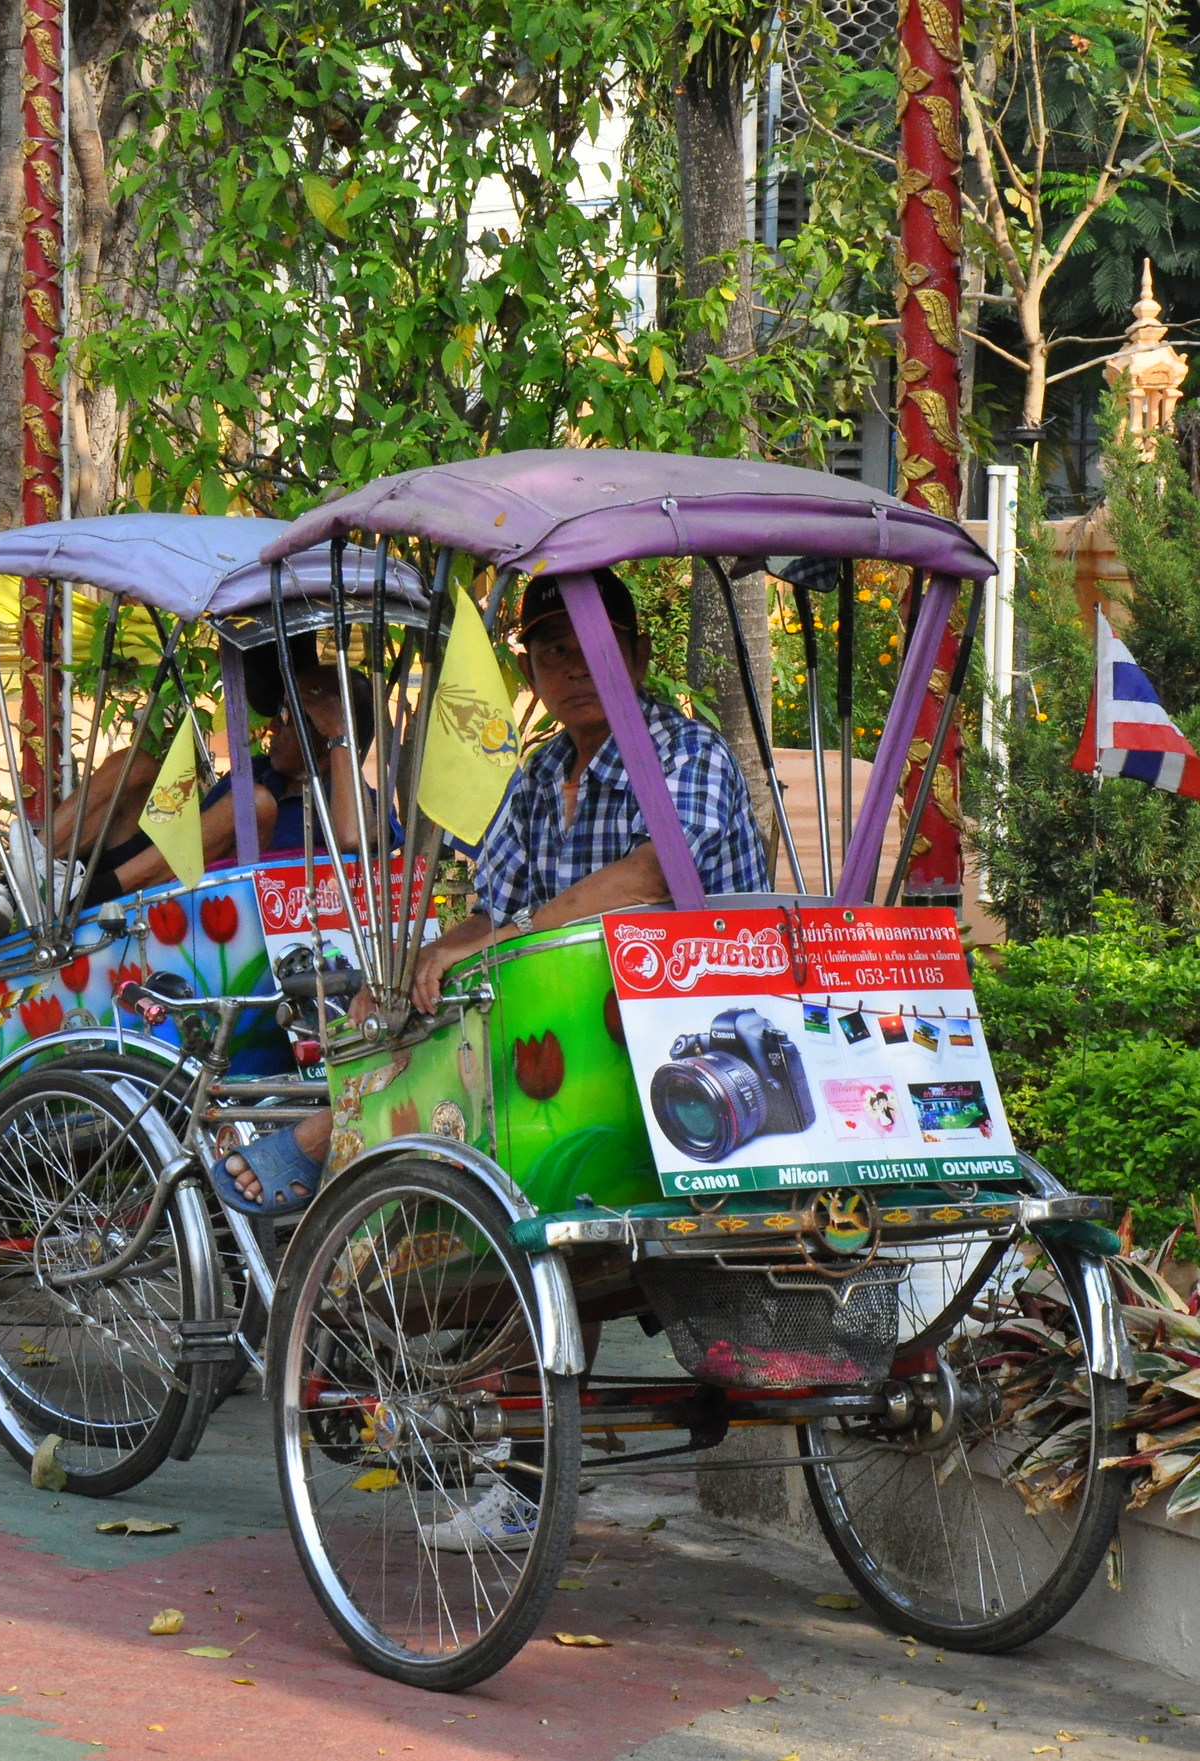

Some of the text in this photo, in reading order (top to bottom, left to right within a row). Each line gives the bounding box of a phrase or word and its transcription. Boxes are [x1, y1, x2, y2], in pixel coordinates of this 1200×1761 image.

[614, 923, 667, 941] ห้องภาพ
[667, 928, 790, 992] มนต์รัก
[855, 967, 945, 986] 053-711185
[711, 1030, 736, 1039] Canon
[306, 1066, 327, 1078] Can
[674, 1160, 1015, 1191] Canon Nikon FUJIFILM OLYMPUS
